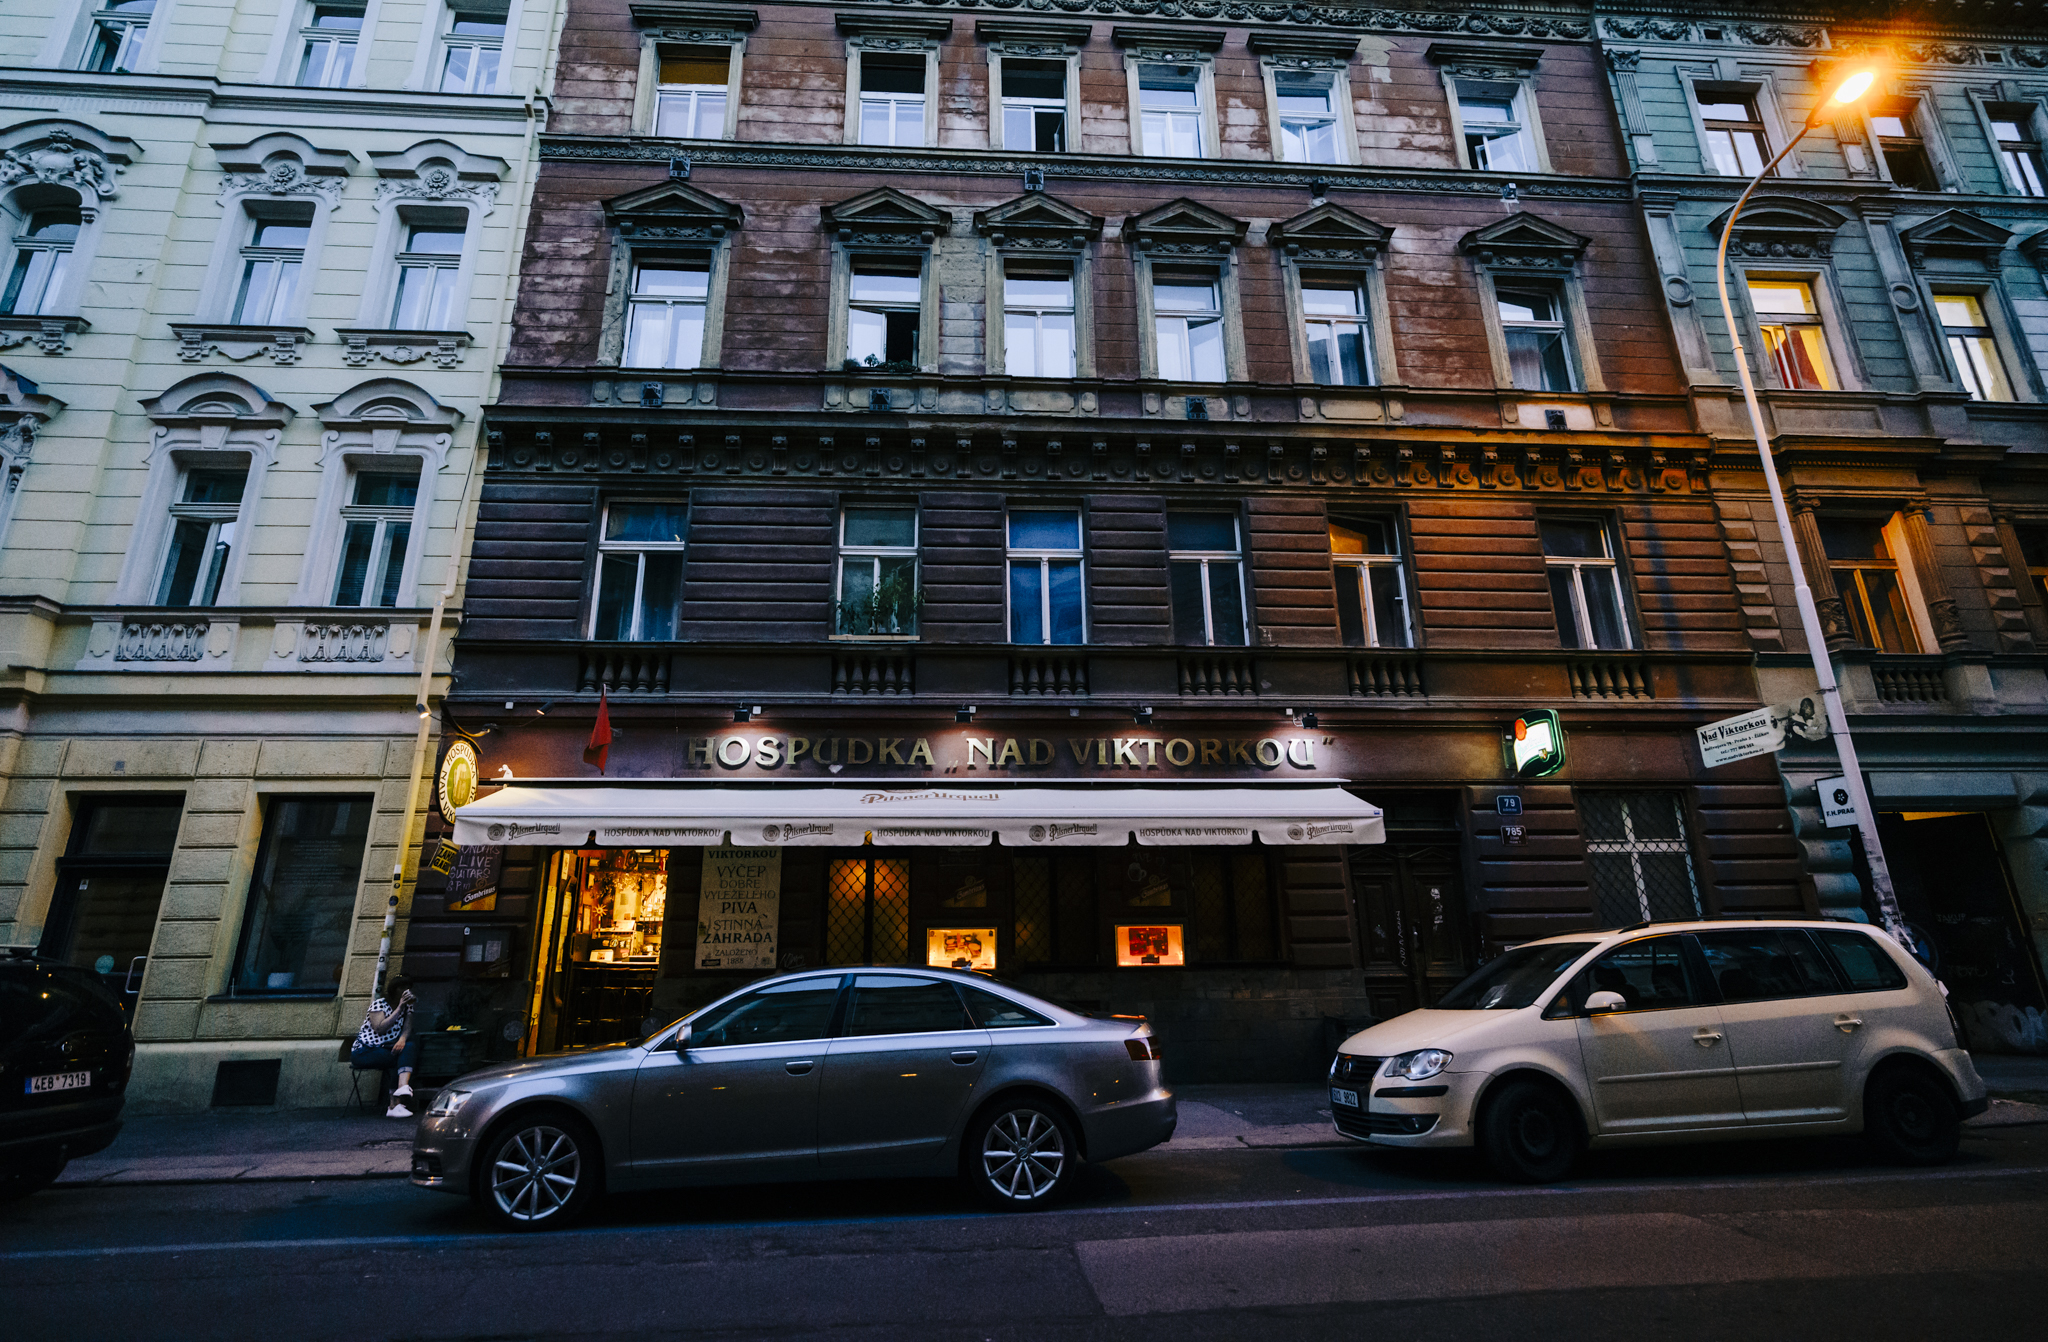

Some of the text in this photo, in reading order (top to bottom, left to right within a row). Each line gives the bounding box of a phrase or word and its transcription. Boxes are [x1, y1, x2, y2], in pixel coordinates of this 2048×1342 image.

[1700, 731, 1718, 745] Nad
[1718, 718, 1766, 739] Viktorkou
[860, 791, 1000, 804] Pilsner Urquell
[1503, 798, 1516, 807] 79
[509, 822, 560, 841] Pilsner Urquell
[653, 828, 671, 837] NAD
[674, 828, 721, 838] VIKTORKOU
[783, 823, 834, 841] Pilsner Urquell
[925, 828, 942, 837] NAD
[944, 828, 990, 838] VIKTORKOU
[1049, 823, 1098, 841] Pilsner Urquell
[1185, 828, 1201, 837] NAD
[1204, 828, 1248, 837] VIKTORKOU
[1306, 821, 1353, 840] Pilsner Urquell
[1505, 827, 1522, 836] 785
[708, 850, 777, 859] VIKTORKOU
[457, 855, 493, 868] LIVE
[449, 866, 490, 879] GUITARS
[717, 863, 766, 878] VÝČEP
[719, 878, 761, 889] DOBŘE
[463, 885, 497, 903] Gambrinus
[721, 901, 757, 914] PIVA
[702, 932, 772, 944] ZAHRADA
[34, 1072, 86, 1091] 4E8 7319
